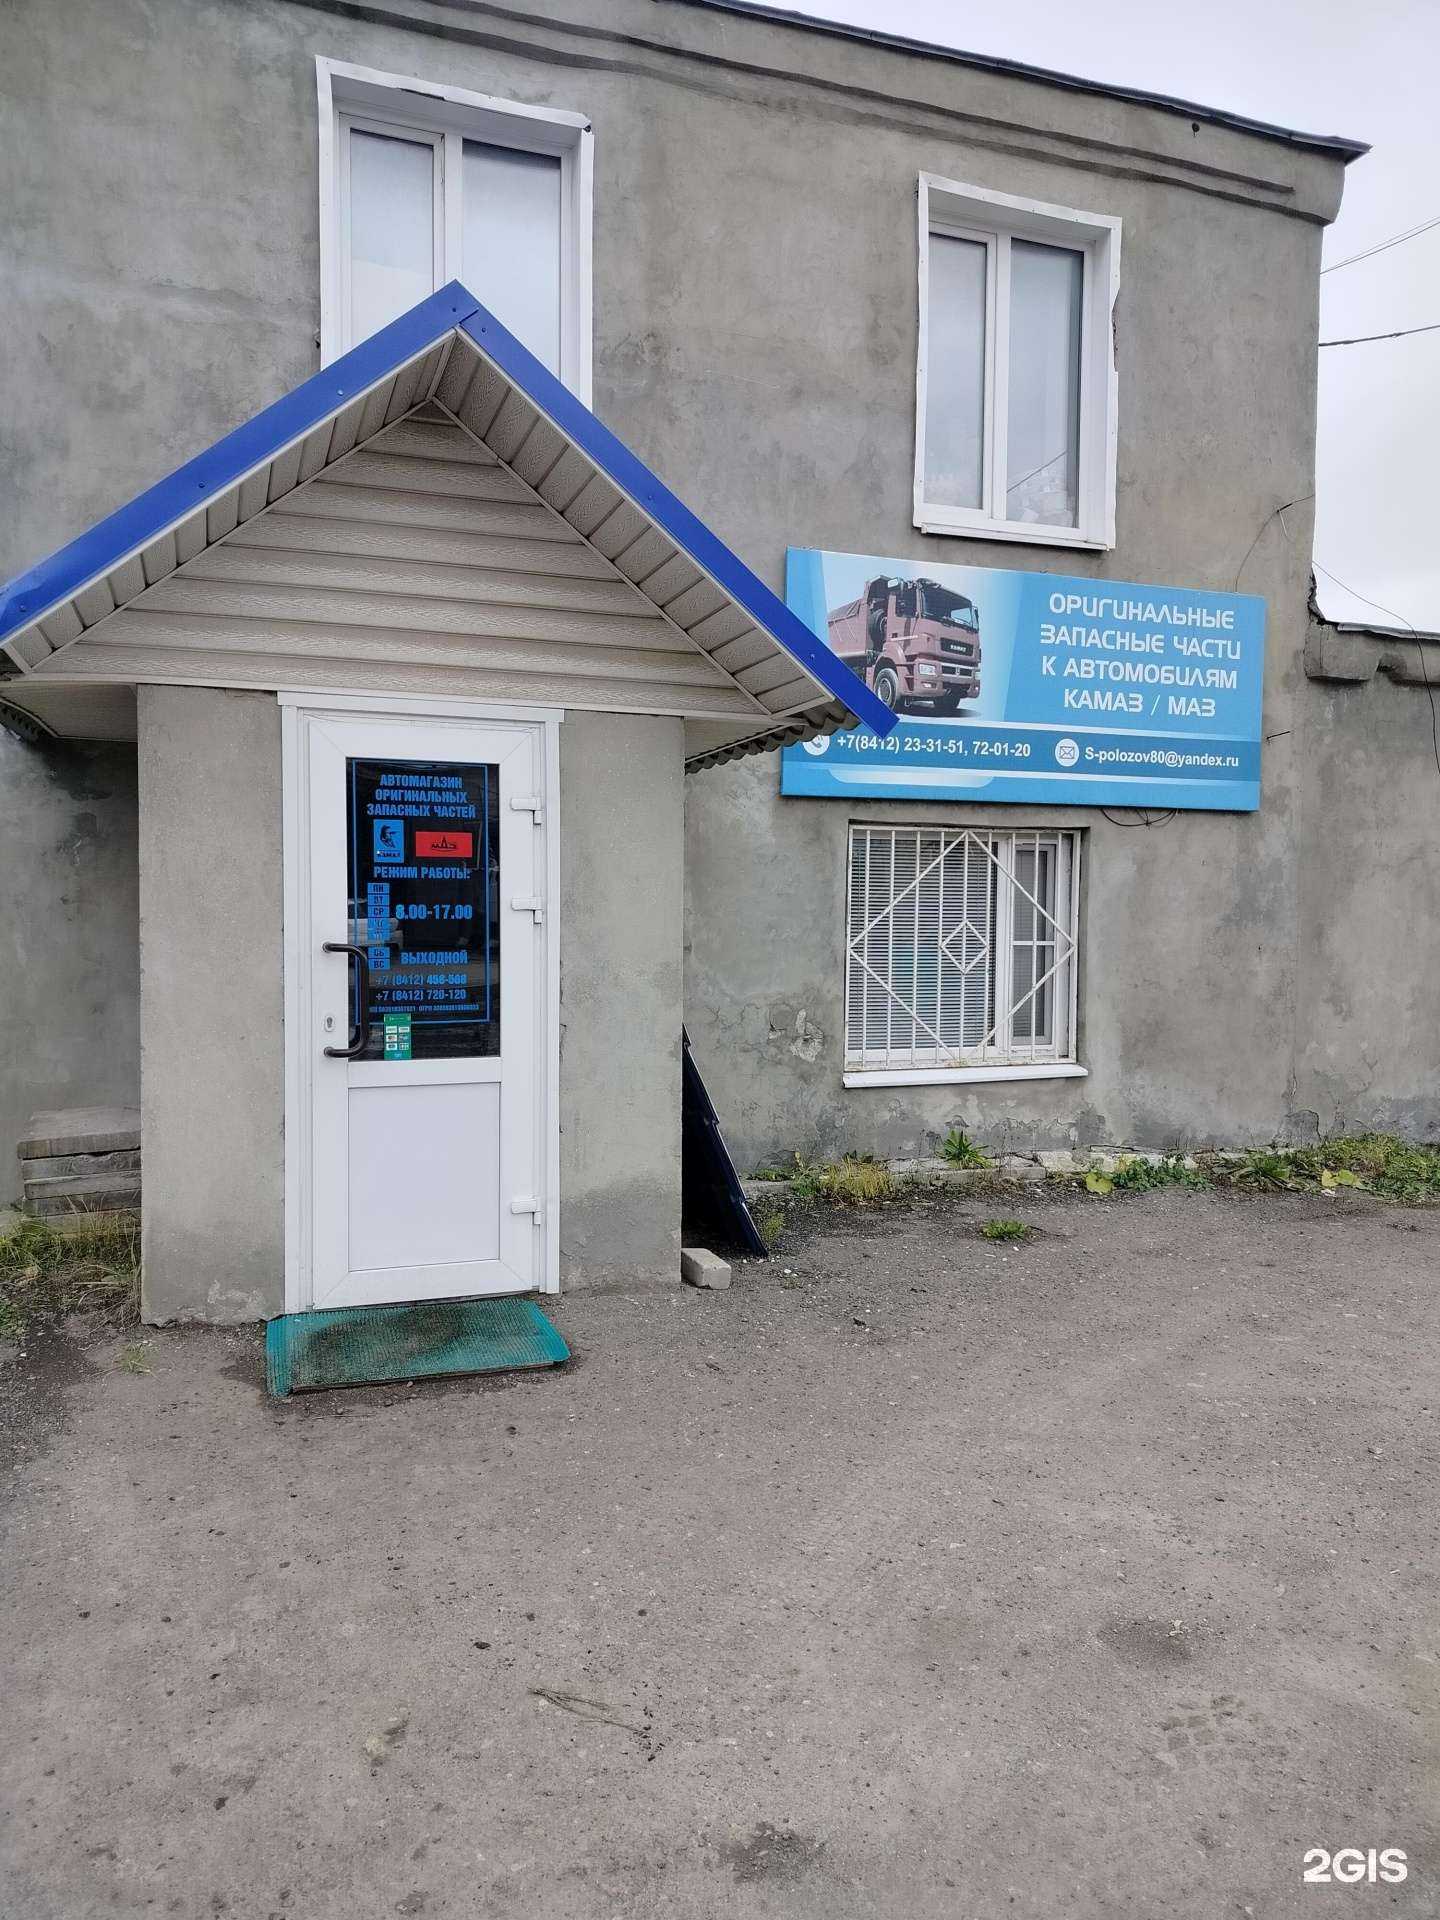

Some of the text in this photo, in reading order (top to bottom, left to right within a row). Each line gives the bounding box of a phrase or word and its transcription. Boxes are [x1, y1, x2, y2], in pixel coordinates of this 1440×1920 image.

[1049, 592, 1234, 630] ОРИГИНАЛЬНЫЕ
[1040, 623, 1241, 660] ЗАПАСНЫЕ ЧАСТИ
[1042, 655, 1237, 689] К АВТОМОБИЛЯМ
[1064, 688, 1144, 713] КАМАЗ
[1168, 696, 1216, 717] МАЗ
[837, 734, 1031, 757] +7(8412) 23-31-51, 72-01-20
[1085, 746, 1239, 768] S-polozov80@yandex.ru
[380, 774, 463, 788] АВТОМАГАЗИН
[375, 789, 468, 804] ОРИГИНАЛЬНЫХ
[367, 803, 476, 818] ЗАПАСНЫХ ЧАСТЕЙ
[373, 866, 417, 879] РЕЖИМ
[395, 904, 473, 920] 8.00-17.00
[400, 950, 468, 966] ВЫХОДНОЙ
